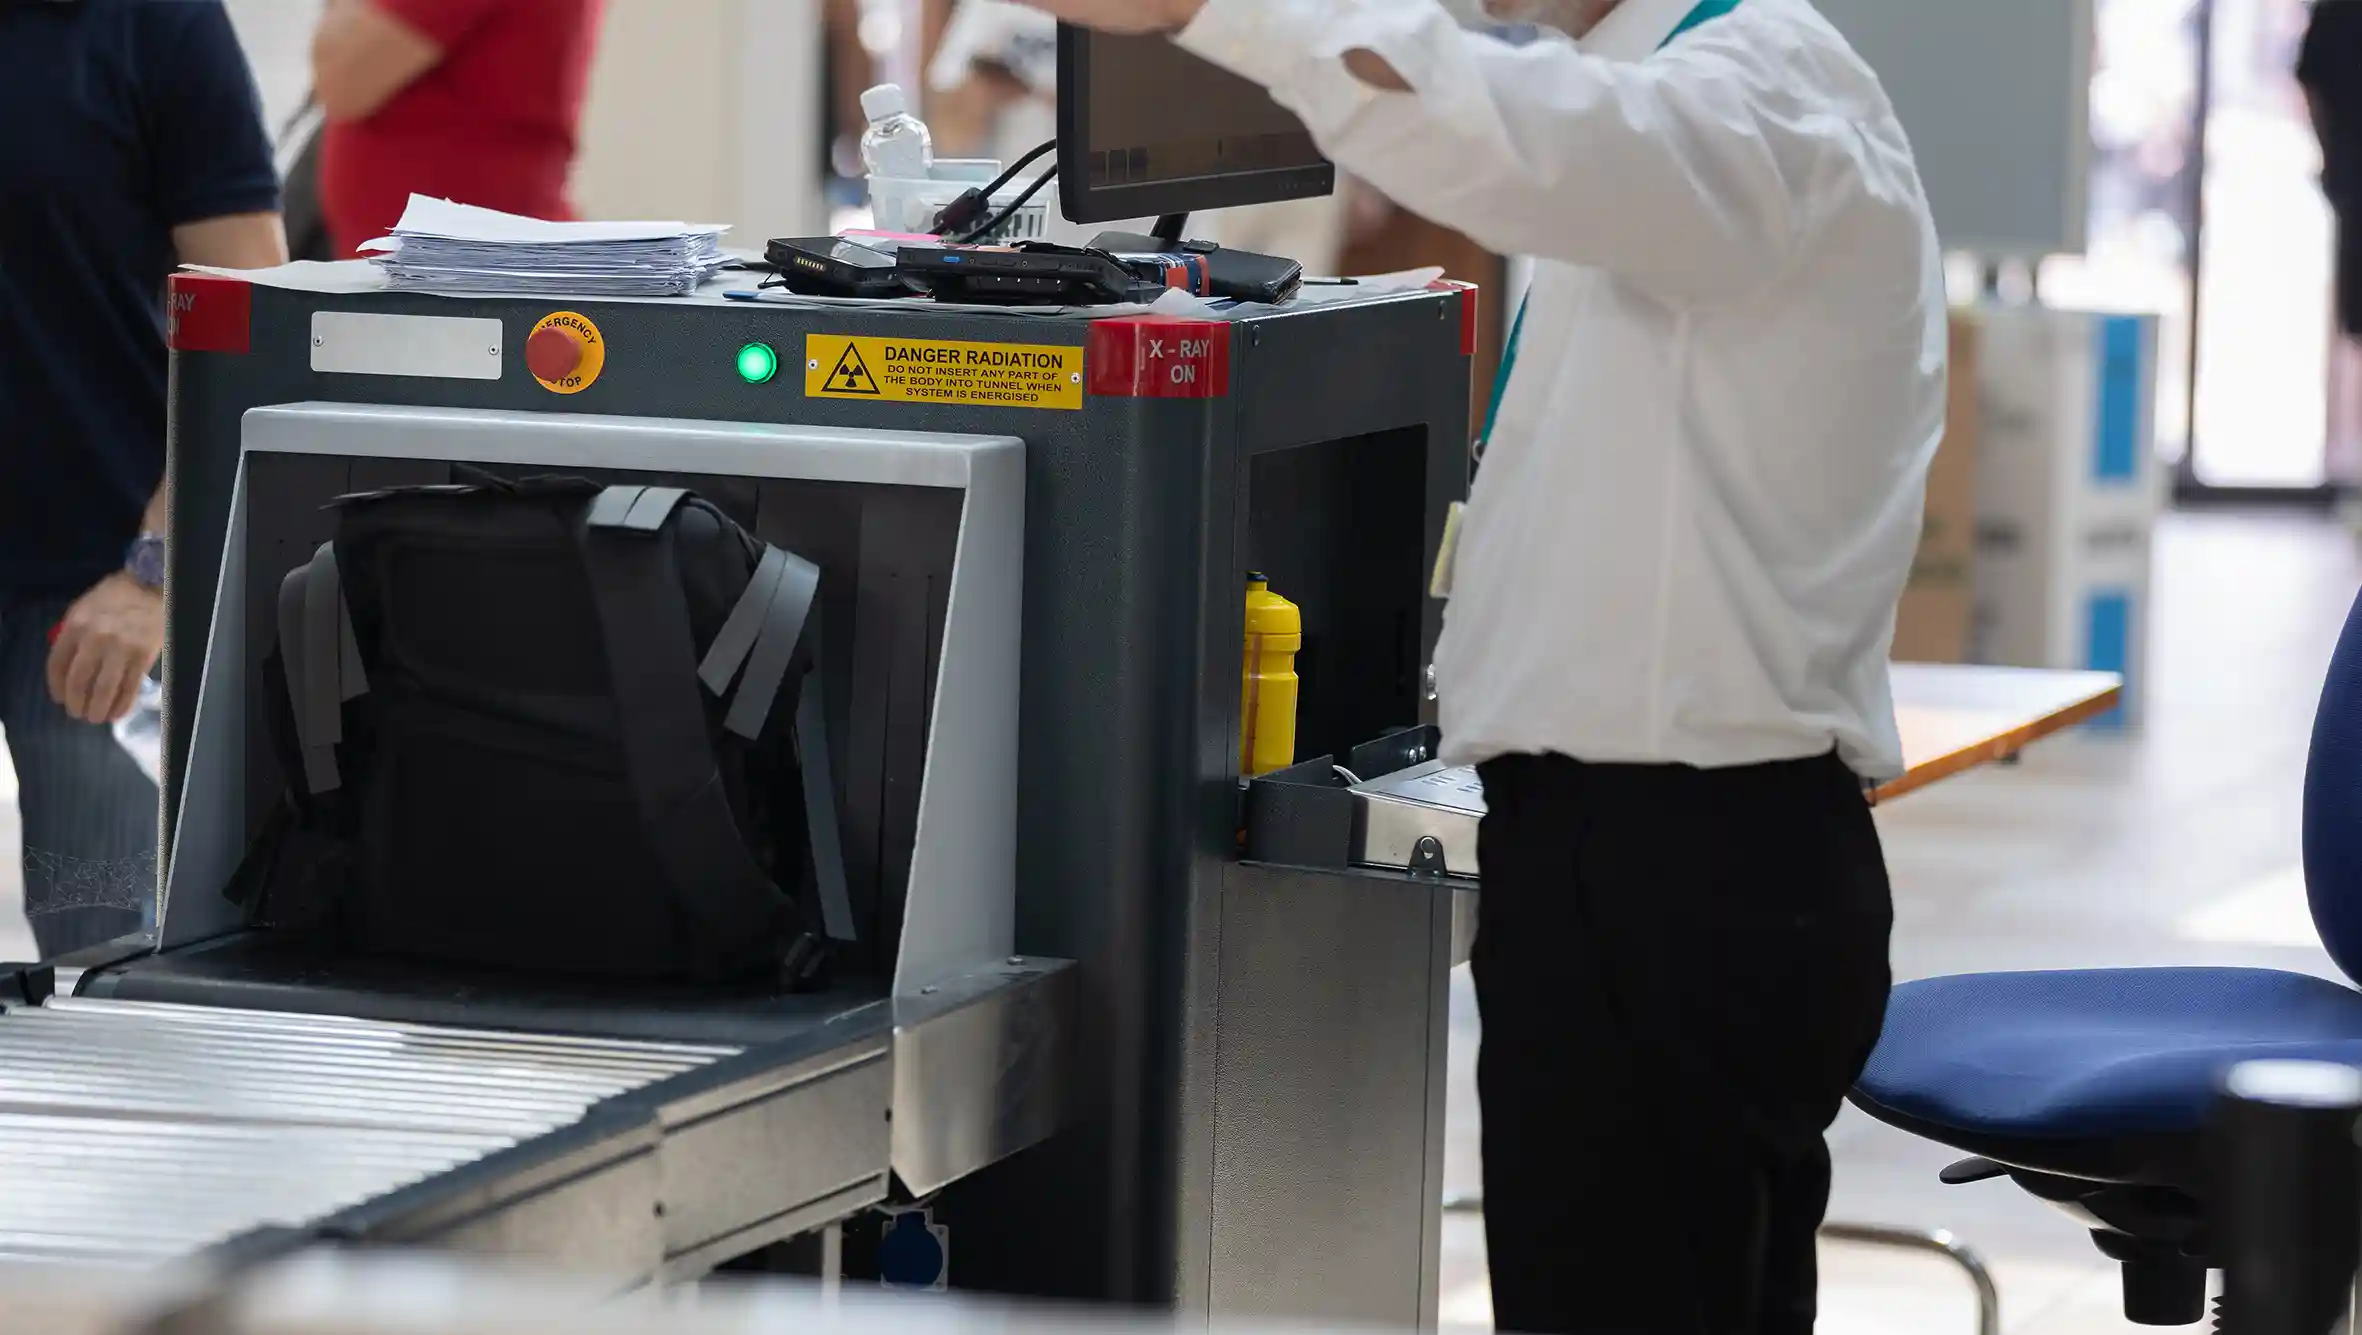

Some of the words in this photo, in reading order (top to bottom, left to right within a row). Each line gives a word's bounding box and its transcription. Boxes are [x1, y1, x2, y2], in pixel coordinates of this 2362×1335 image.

[541, 316, 597, 344] ERGENCY
[885, 346, 961, 364] DANGER
[966, 350, 1063, 369] RADIATION
[887, 364, 905, 373] DO
[908, 365, 933, 375] NOT
[935, 367, 978, 377] INSERT
[980, 369, 1005, 379] ANY
[1008, 370, 1039, 380] PART
[1042, 372, 1058, 381] OF
[1170, 364, 1196, 384] ON
[551, 376, 582, 388] TOP
[884, 375, 906, 385] THE
[909, 376, 944, 386] BODY
[946, 378, 973, 388] INTO
[976, 380, 1023, 391] TUNNEL
[1026, 382, 1062, 392] WHEN
[905, 387, 953, 398] SYSTEM
[956, 389, 967, 399] IS
[970, 391, 1039, 402] ENERGISED
